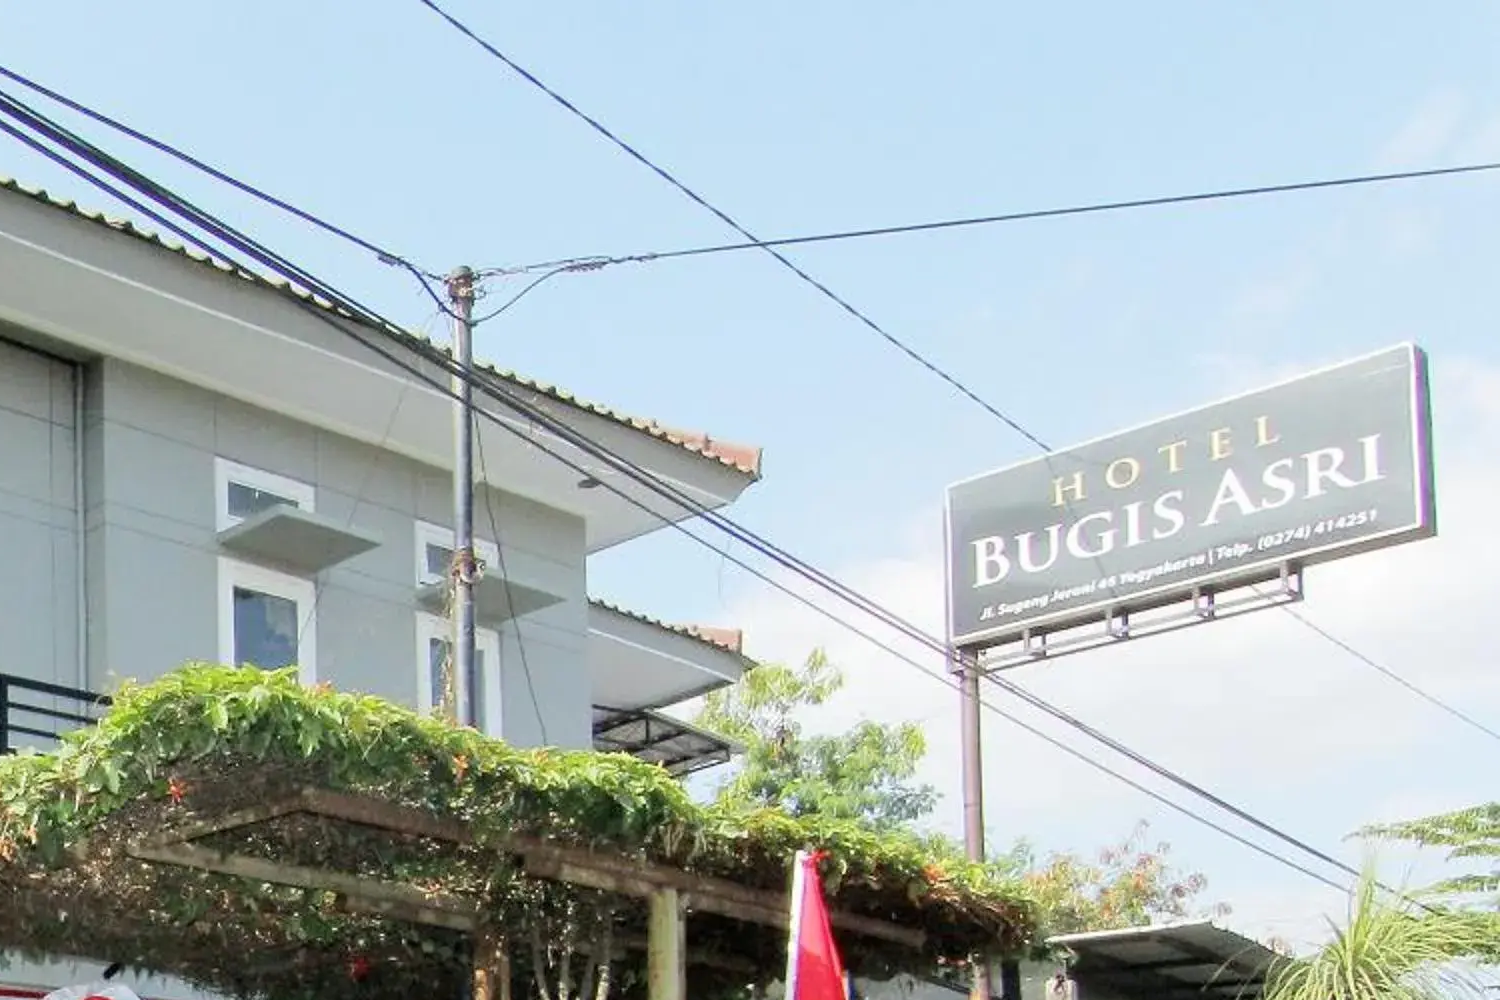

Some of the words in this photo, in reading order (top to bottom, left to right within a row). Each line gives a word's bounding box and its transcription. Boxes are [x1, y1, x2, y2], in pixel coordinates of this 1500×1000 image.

[1051, 415, 1281, 508] HOTEL
[971, 489, 1186, 589] BUGIS
[1201, 434, 1388, 526] ASRI
[1119, 552, 1205, 587] Yogyakarta
